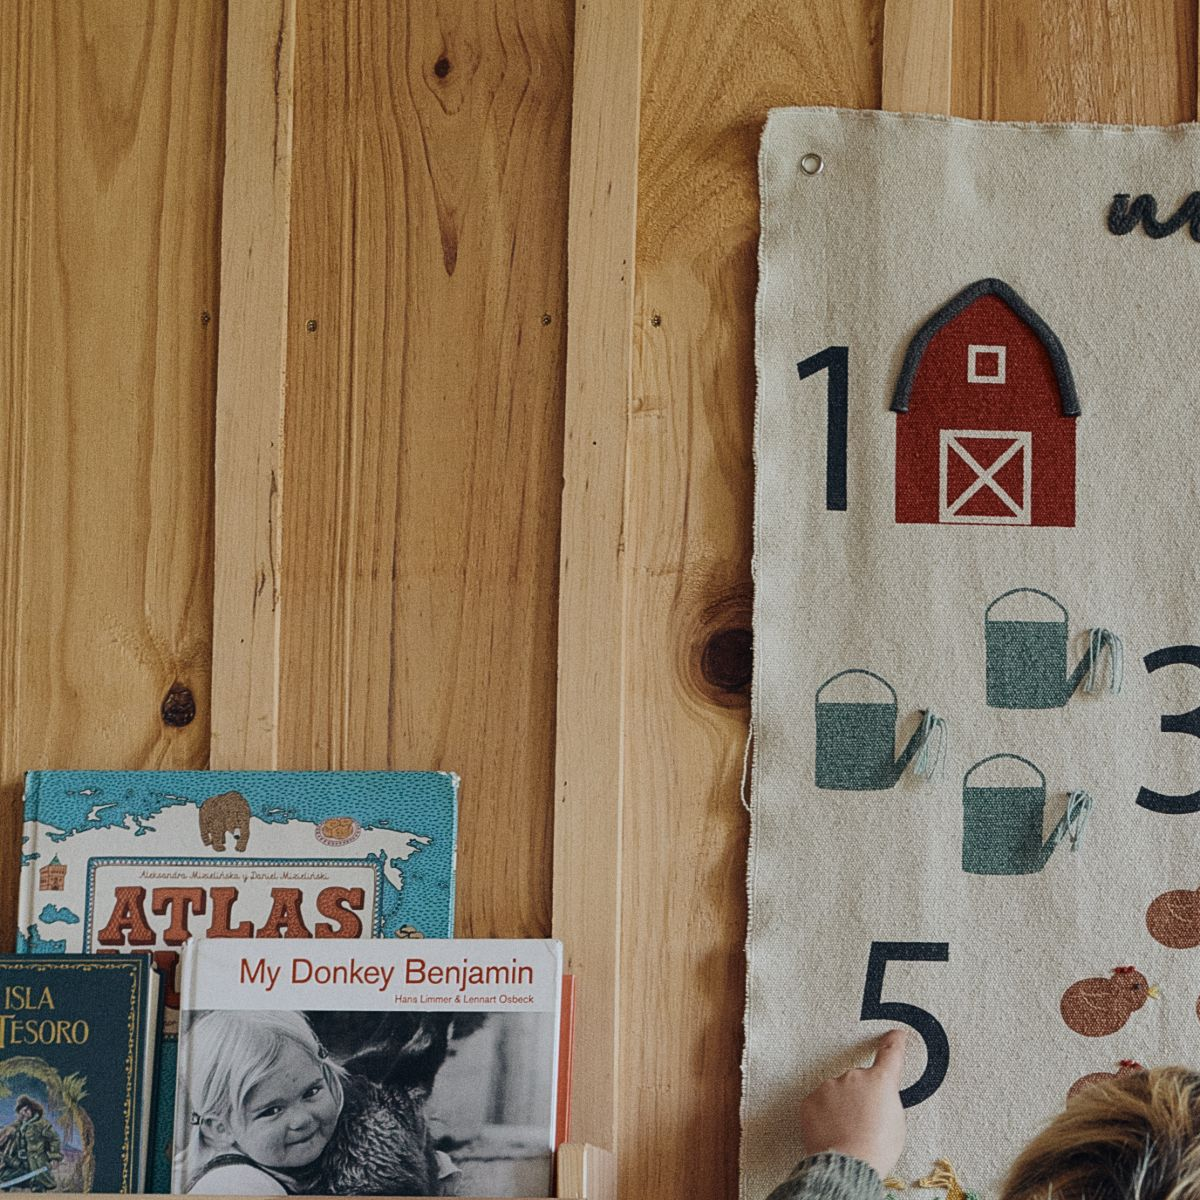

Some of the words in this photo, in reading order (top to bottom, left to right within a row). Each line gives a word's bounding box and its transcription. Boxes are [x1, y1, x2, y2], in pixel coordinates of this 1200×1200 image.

[797, 346, 848, 512] 1
[98, 886, 365, 946] ATLAS
[4, 985, 56, 1011] ISLA
[239, 958, 281, 992] My
[291, 958, 395, 992] Donkey
[405, 958, 534, 992] Benjamin
[394, 994, 418, 1004] Hans
[454, 994, 461, 1004] &
[463, 994, 497, 1004] Lennart
[499, 994, 535, 1004] Osbeck
[860, 941, 950, 1109] 5
